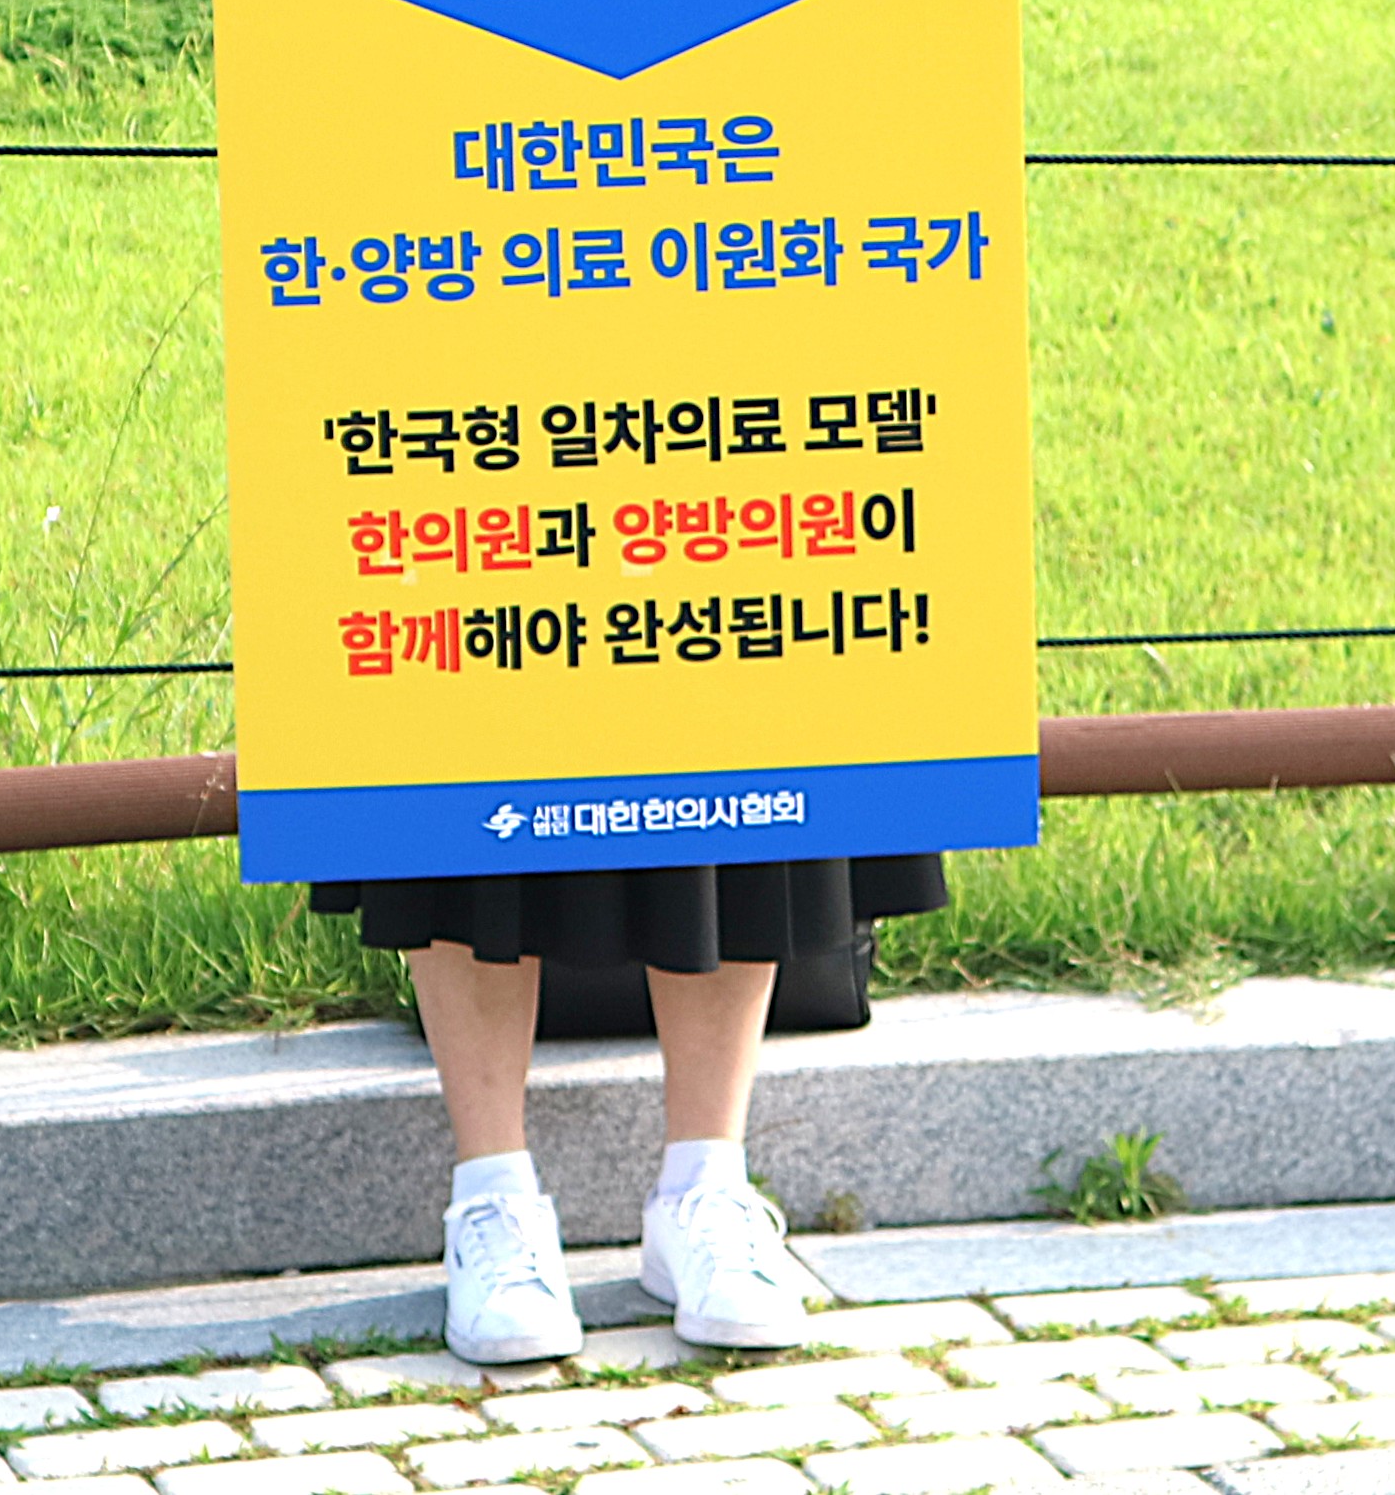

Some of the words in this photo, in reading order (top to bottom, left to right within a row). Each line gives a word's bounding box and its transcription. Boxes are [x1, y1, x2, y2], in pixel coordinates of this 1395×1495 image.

[453, 115, 780, 192] 대한민국은
[501, 227, 631, 298] 의료
[650, 216, 844, 292] 이원화
[861, 211, 990, 283] 국가
[323, 404, 520, 476] '한국형
[541, 396, 787, 469] 일차의료
[804, 387, 937, 454] 모델'
[347, 502, 597, 576] 한의원과
[613, 487, 916, 565] 양방의원이
[338, 602, 588, 677] 함께해야
[603, 587, 930, 666] 완성됩니다!
[574, 790, 804, 835] 대한한의사협회
